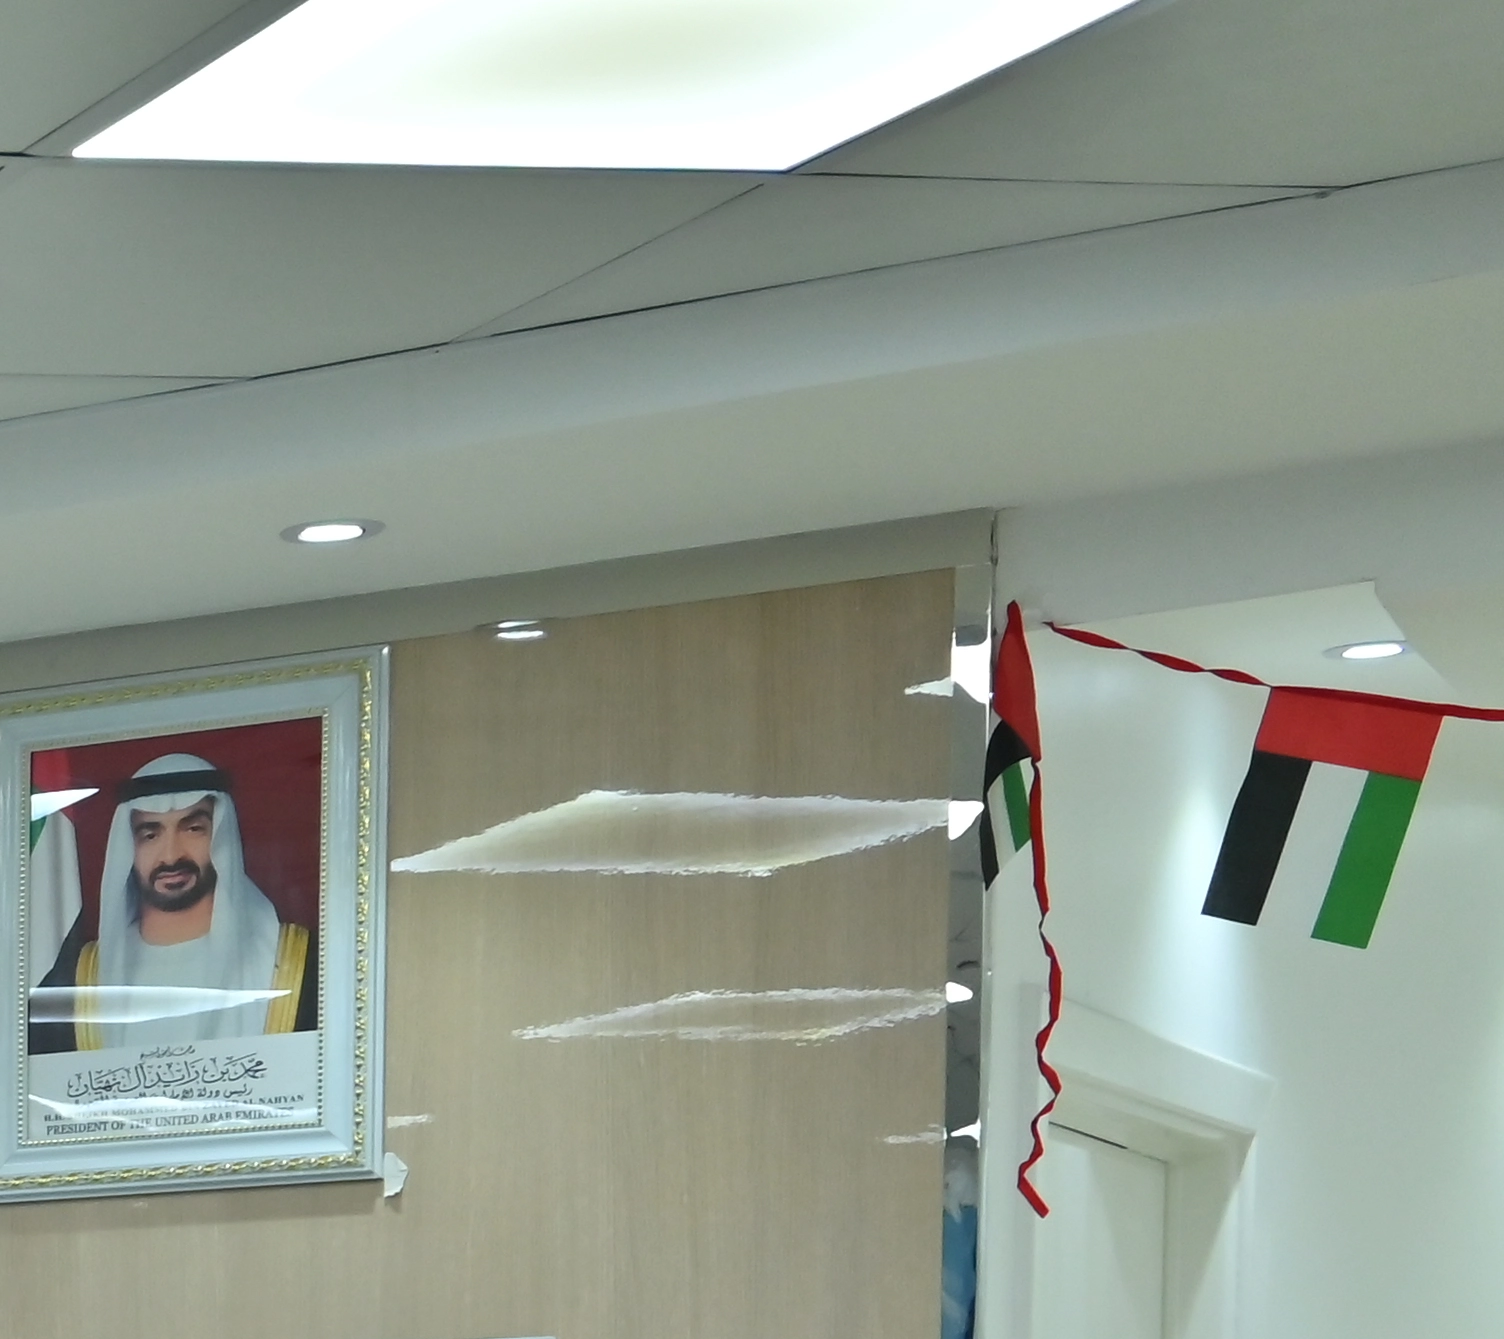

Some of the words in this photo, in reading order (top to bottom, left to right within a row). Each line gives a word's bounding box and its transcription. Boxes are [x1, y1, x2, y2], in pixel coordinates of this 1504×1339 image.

[197, 1087, 220, 1098] دولة
[223, 1083, 253, 1099] رئيس
[259, 1094, 305, 1105] NAHYAN
[46, 1121, 110, 1136] PRESIDENT
[155, 1114, 199, 1127] UNITED
[201, 1111, 233, 1123] ARAB
